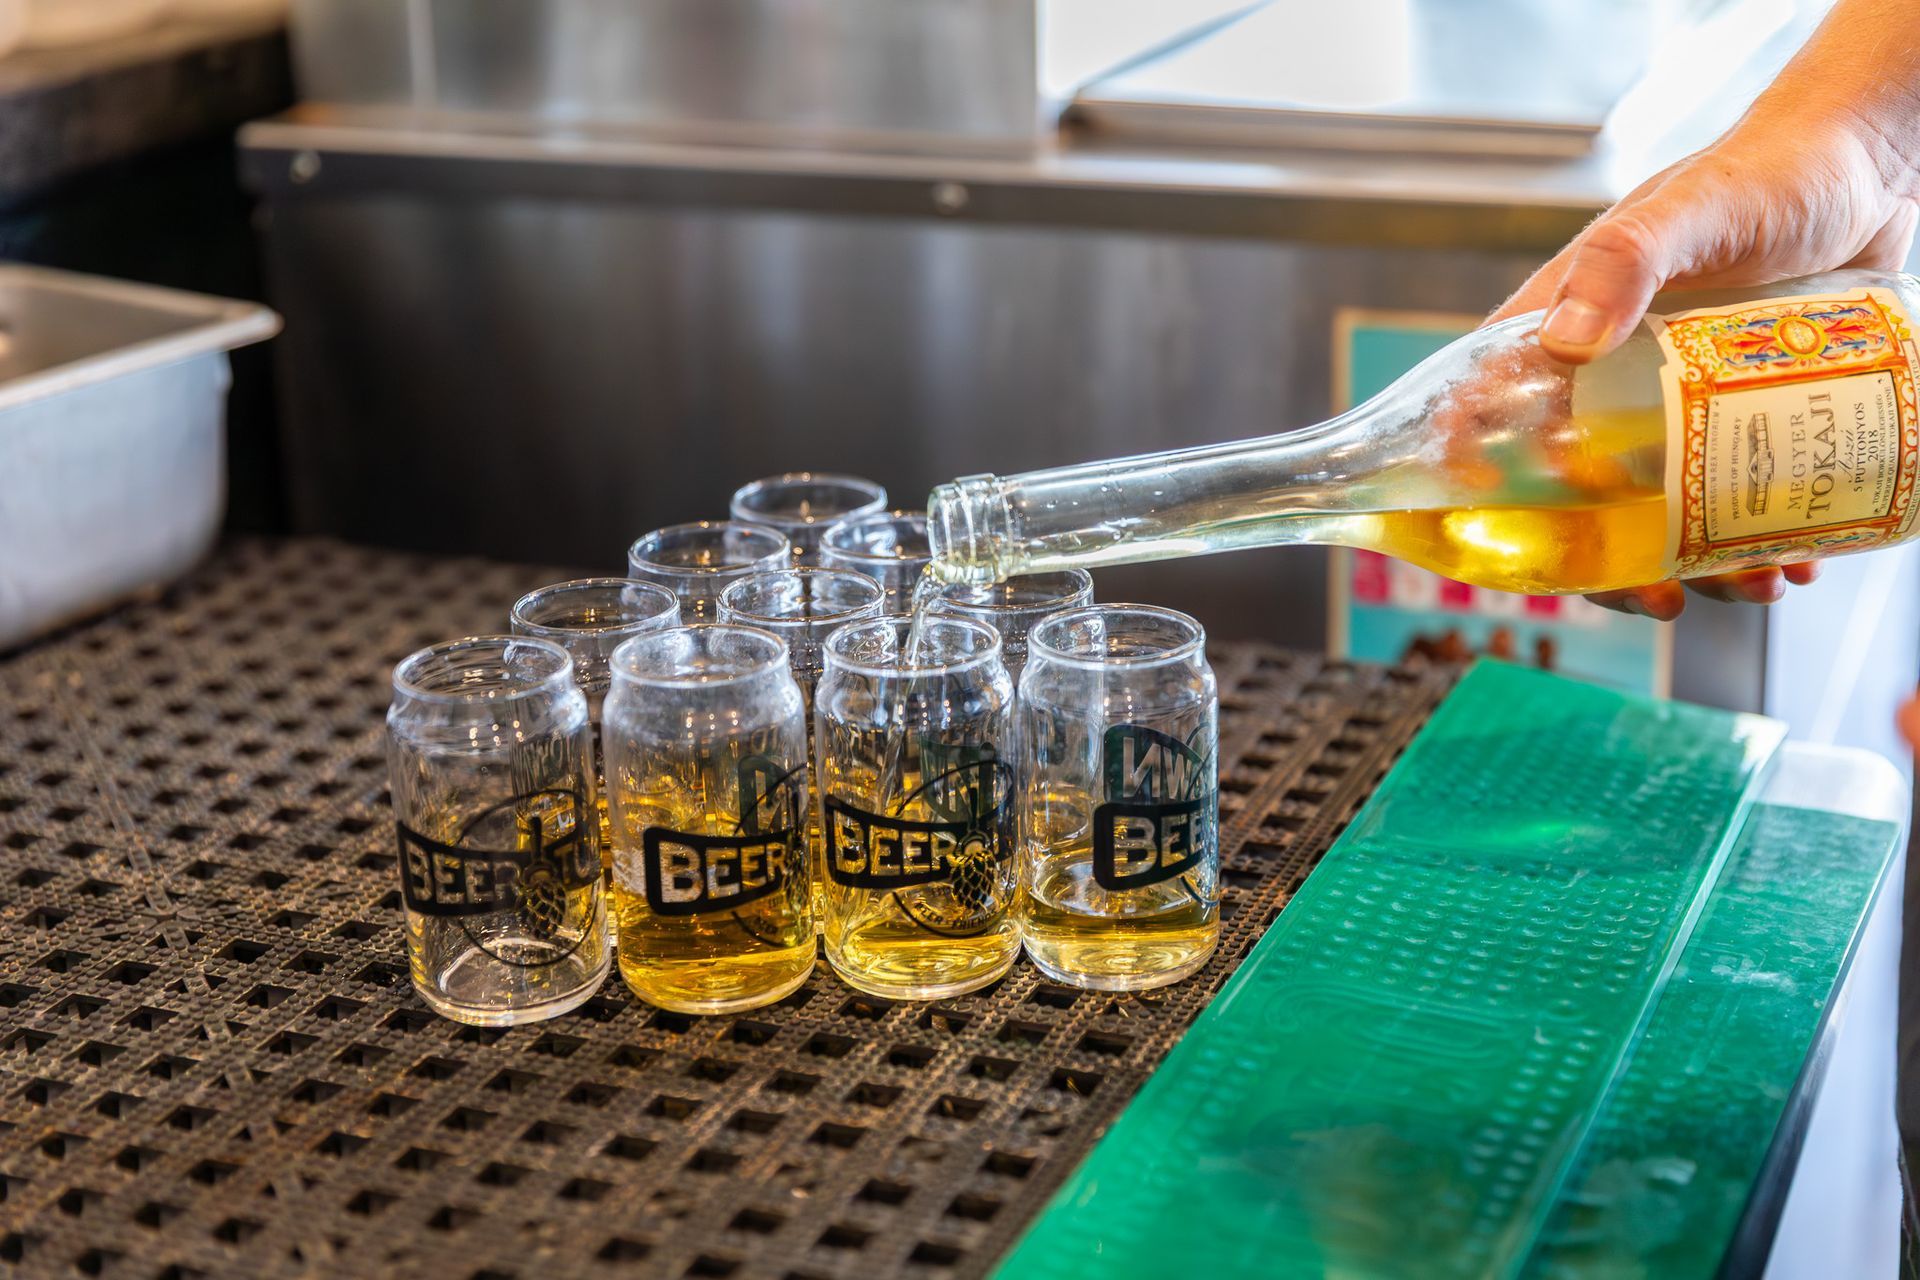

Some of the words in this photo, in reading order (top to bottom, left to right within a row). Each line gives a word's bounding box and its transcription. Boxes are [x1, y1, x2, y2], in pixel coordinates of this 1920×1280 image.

[1884, 386, 1896, 412] WINE
[1731, 416, 1743, 464] HUNGARY
[1853, 401, 1867, 484] PUTTONYOS
[1867, 429, 1879, 462] 2018
[1889, 414, 1897, 440] TOKAJI
[1731, 466, 1740, 479] OF
[1788, 412, 1807, 511] MEGYER
[1806, 391, 1837, 520] TOKAJI
[1886, 441, 1896, 484] QUALITY
[1729, 481, 1740, 520] PRODUCT
[1872, 481, 1883, 505] TOKAJI
[834, 811, 957, 875] BEER
[404, 837, 520, 905] BEER
[658, 840, 788, 904] BEER
